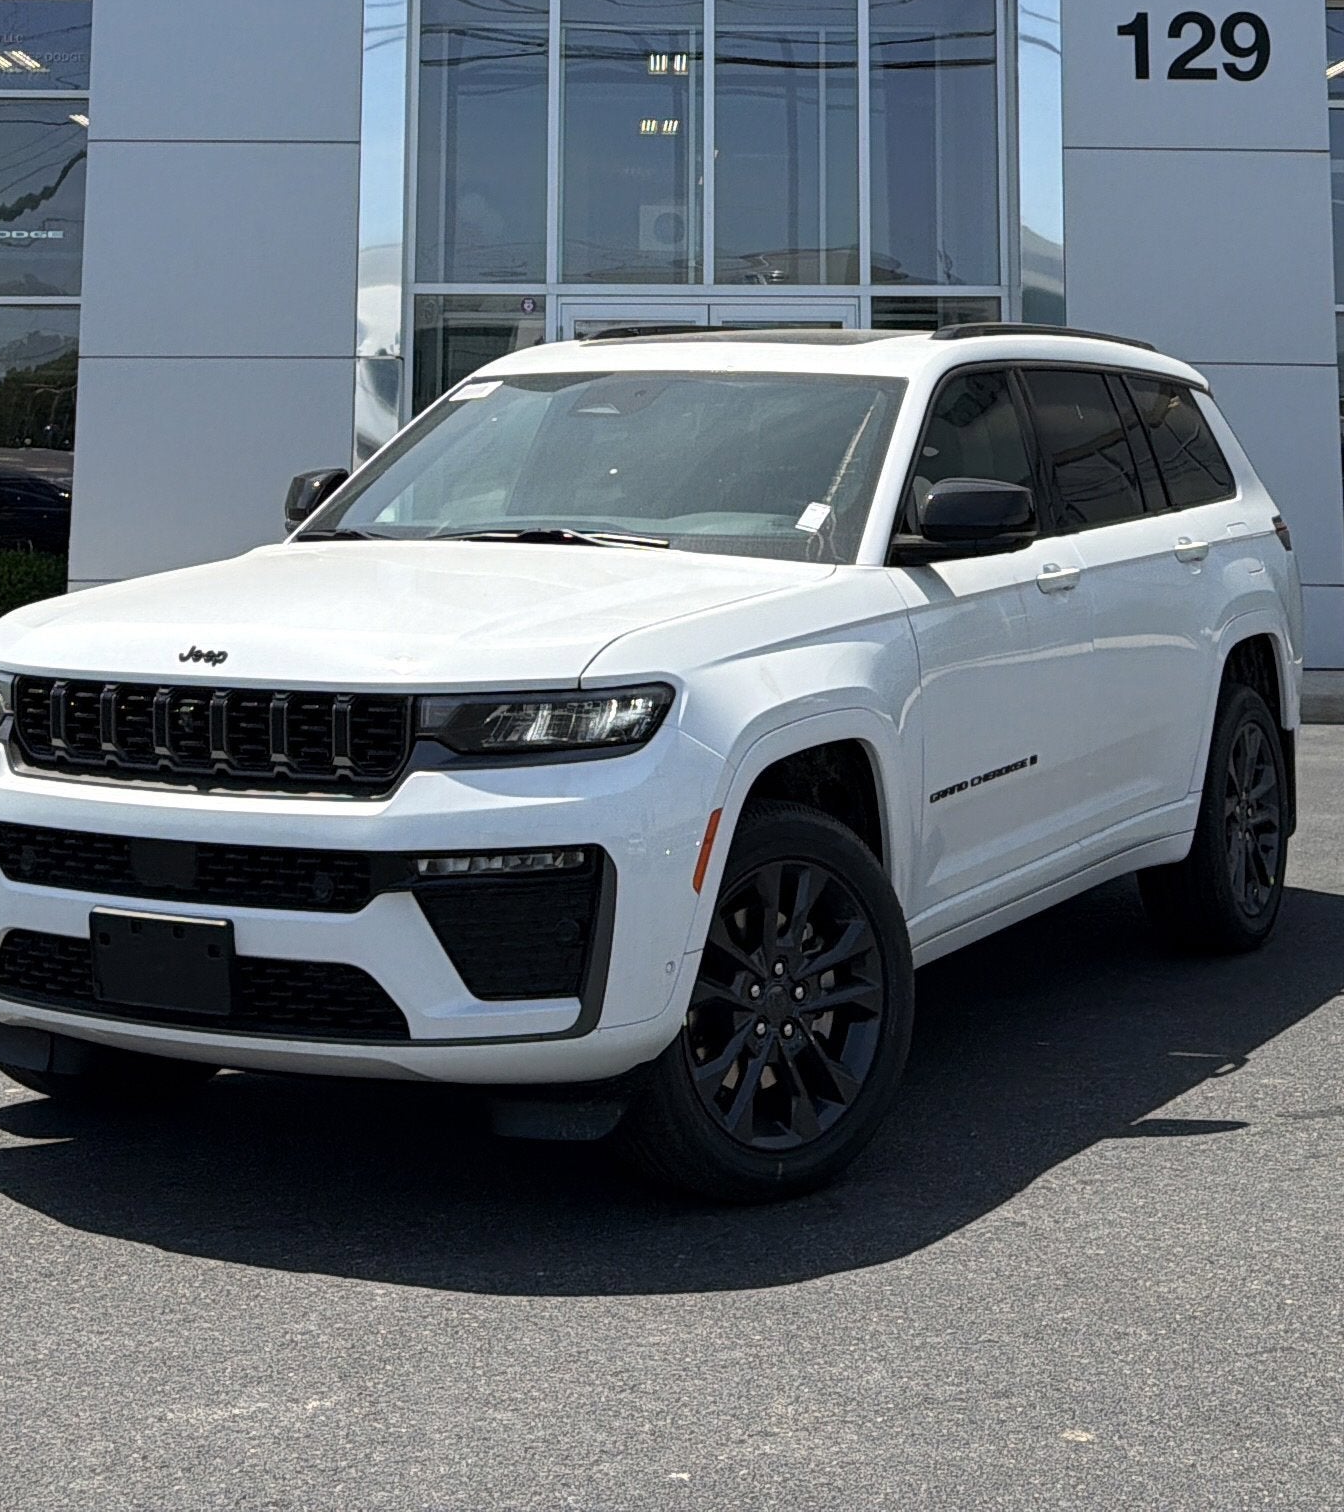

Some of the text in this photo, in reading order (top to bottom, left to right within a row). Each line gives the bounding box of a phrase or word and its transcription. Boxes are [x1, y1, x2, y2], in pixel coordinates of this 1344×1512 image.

[2, 33, 23, 44] LLC
[1116, 11, 1271, 81] 129
[179, 645, 228, 667] Jeep
[929, 780, 969, 804] GRAND
